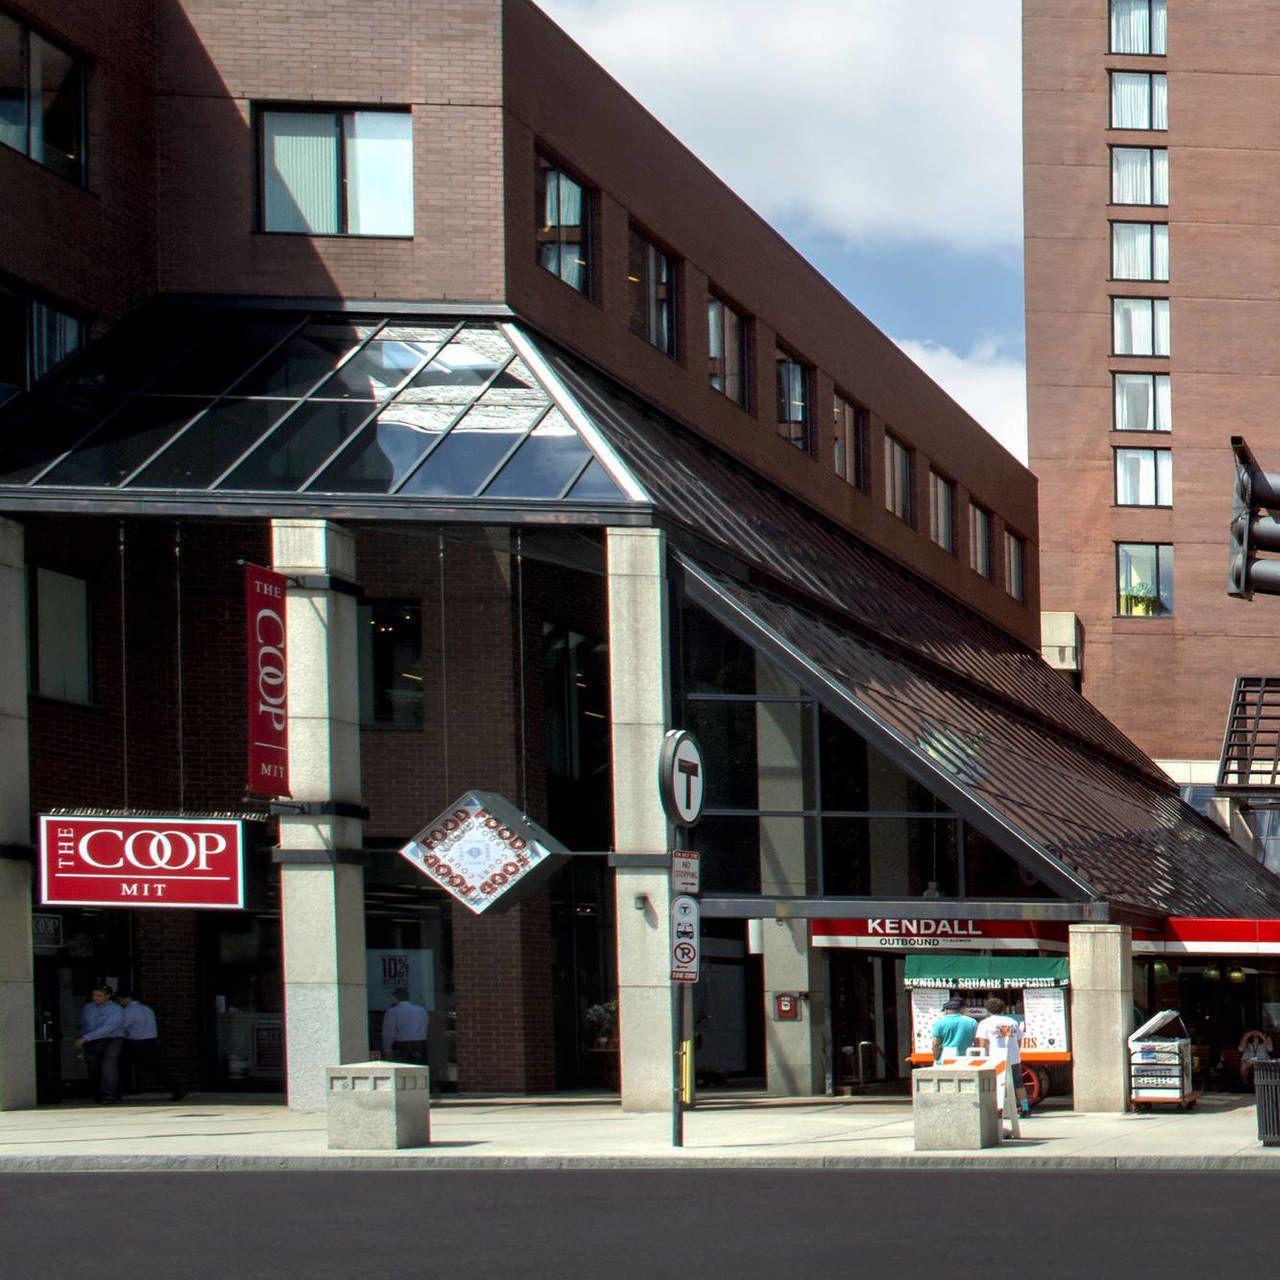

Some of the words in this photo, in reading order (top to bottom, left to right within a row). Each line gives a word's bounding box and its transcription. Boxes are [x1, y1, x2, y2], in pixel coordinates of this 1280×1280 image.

[254, 580, 281, 598] THE
[256, 608, 286, 731] COOP
[260, 762, 286, 779] MIT
[678, 758, 699, 810] T
[420, 808, 470, 850] FOOD
[475, 809, 527, 850] FOOD
[58, 827, 74, 868] THE
[78, 829, 227, 870] COOP
[121, 883, 166, 897] MIT
[867, 919, 982, 935] KENDALL
[879, 937, 940, 947] OUTBOUND
[904, 978, 956, 989] KENDALL
[958, 978, 1001, 989] SQUARE
[1003, 978, 1055, 988] POPCORN
